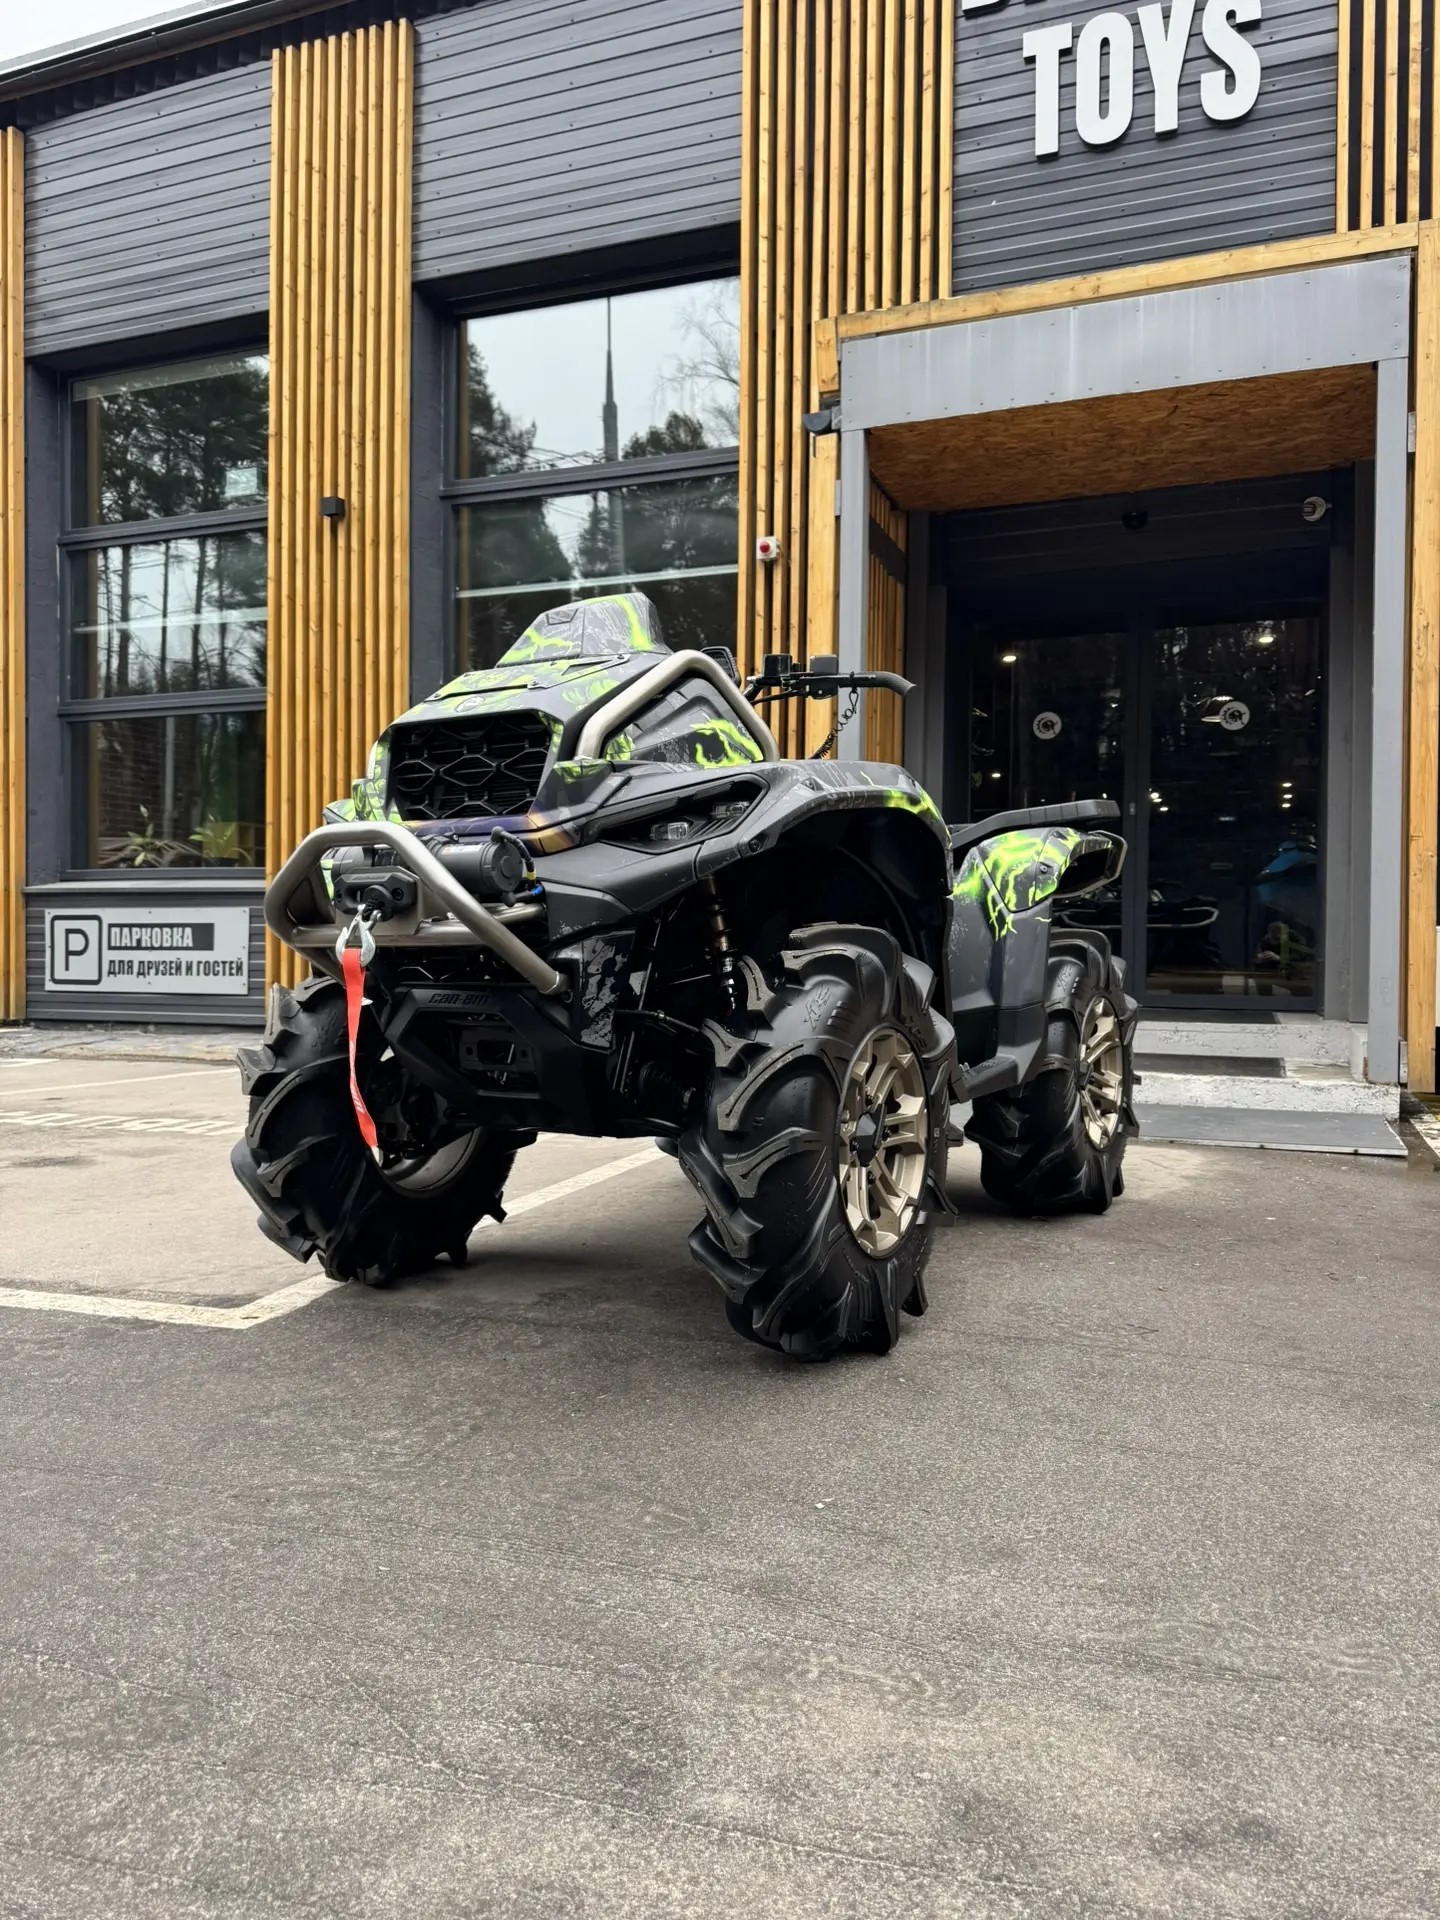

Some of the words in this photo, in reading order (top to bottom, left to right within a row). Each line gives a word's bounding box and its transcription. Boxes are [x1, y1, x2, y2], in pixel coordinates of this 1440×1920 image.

[1022, 0, 1262, 157] TOYS
[64, 928, 90, 971] P
[109, 926, 194, 948] ПАРКОВКА
[107, 959, 134, 977] ДЛЯ
[136, 957, 183, 979] ДРУЗЕЙ
[185, 960, 194, 977] И
[196, 957, 244, 977] ГОСТЕЙ
